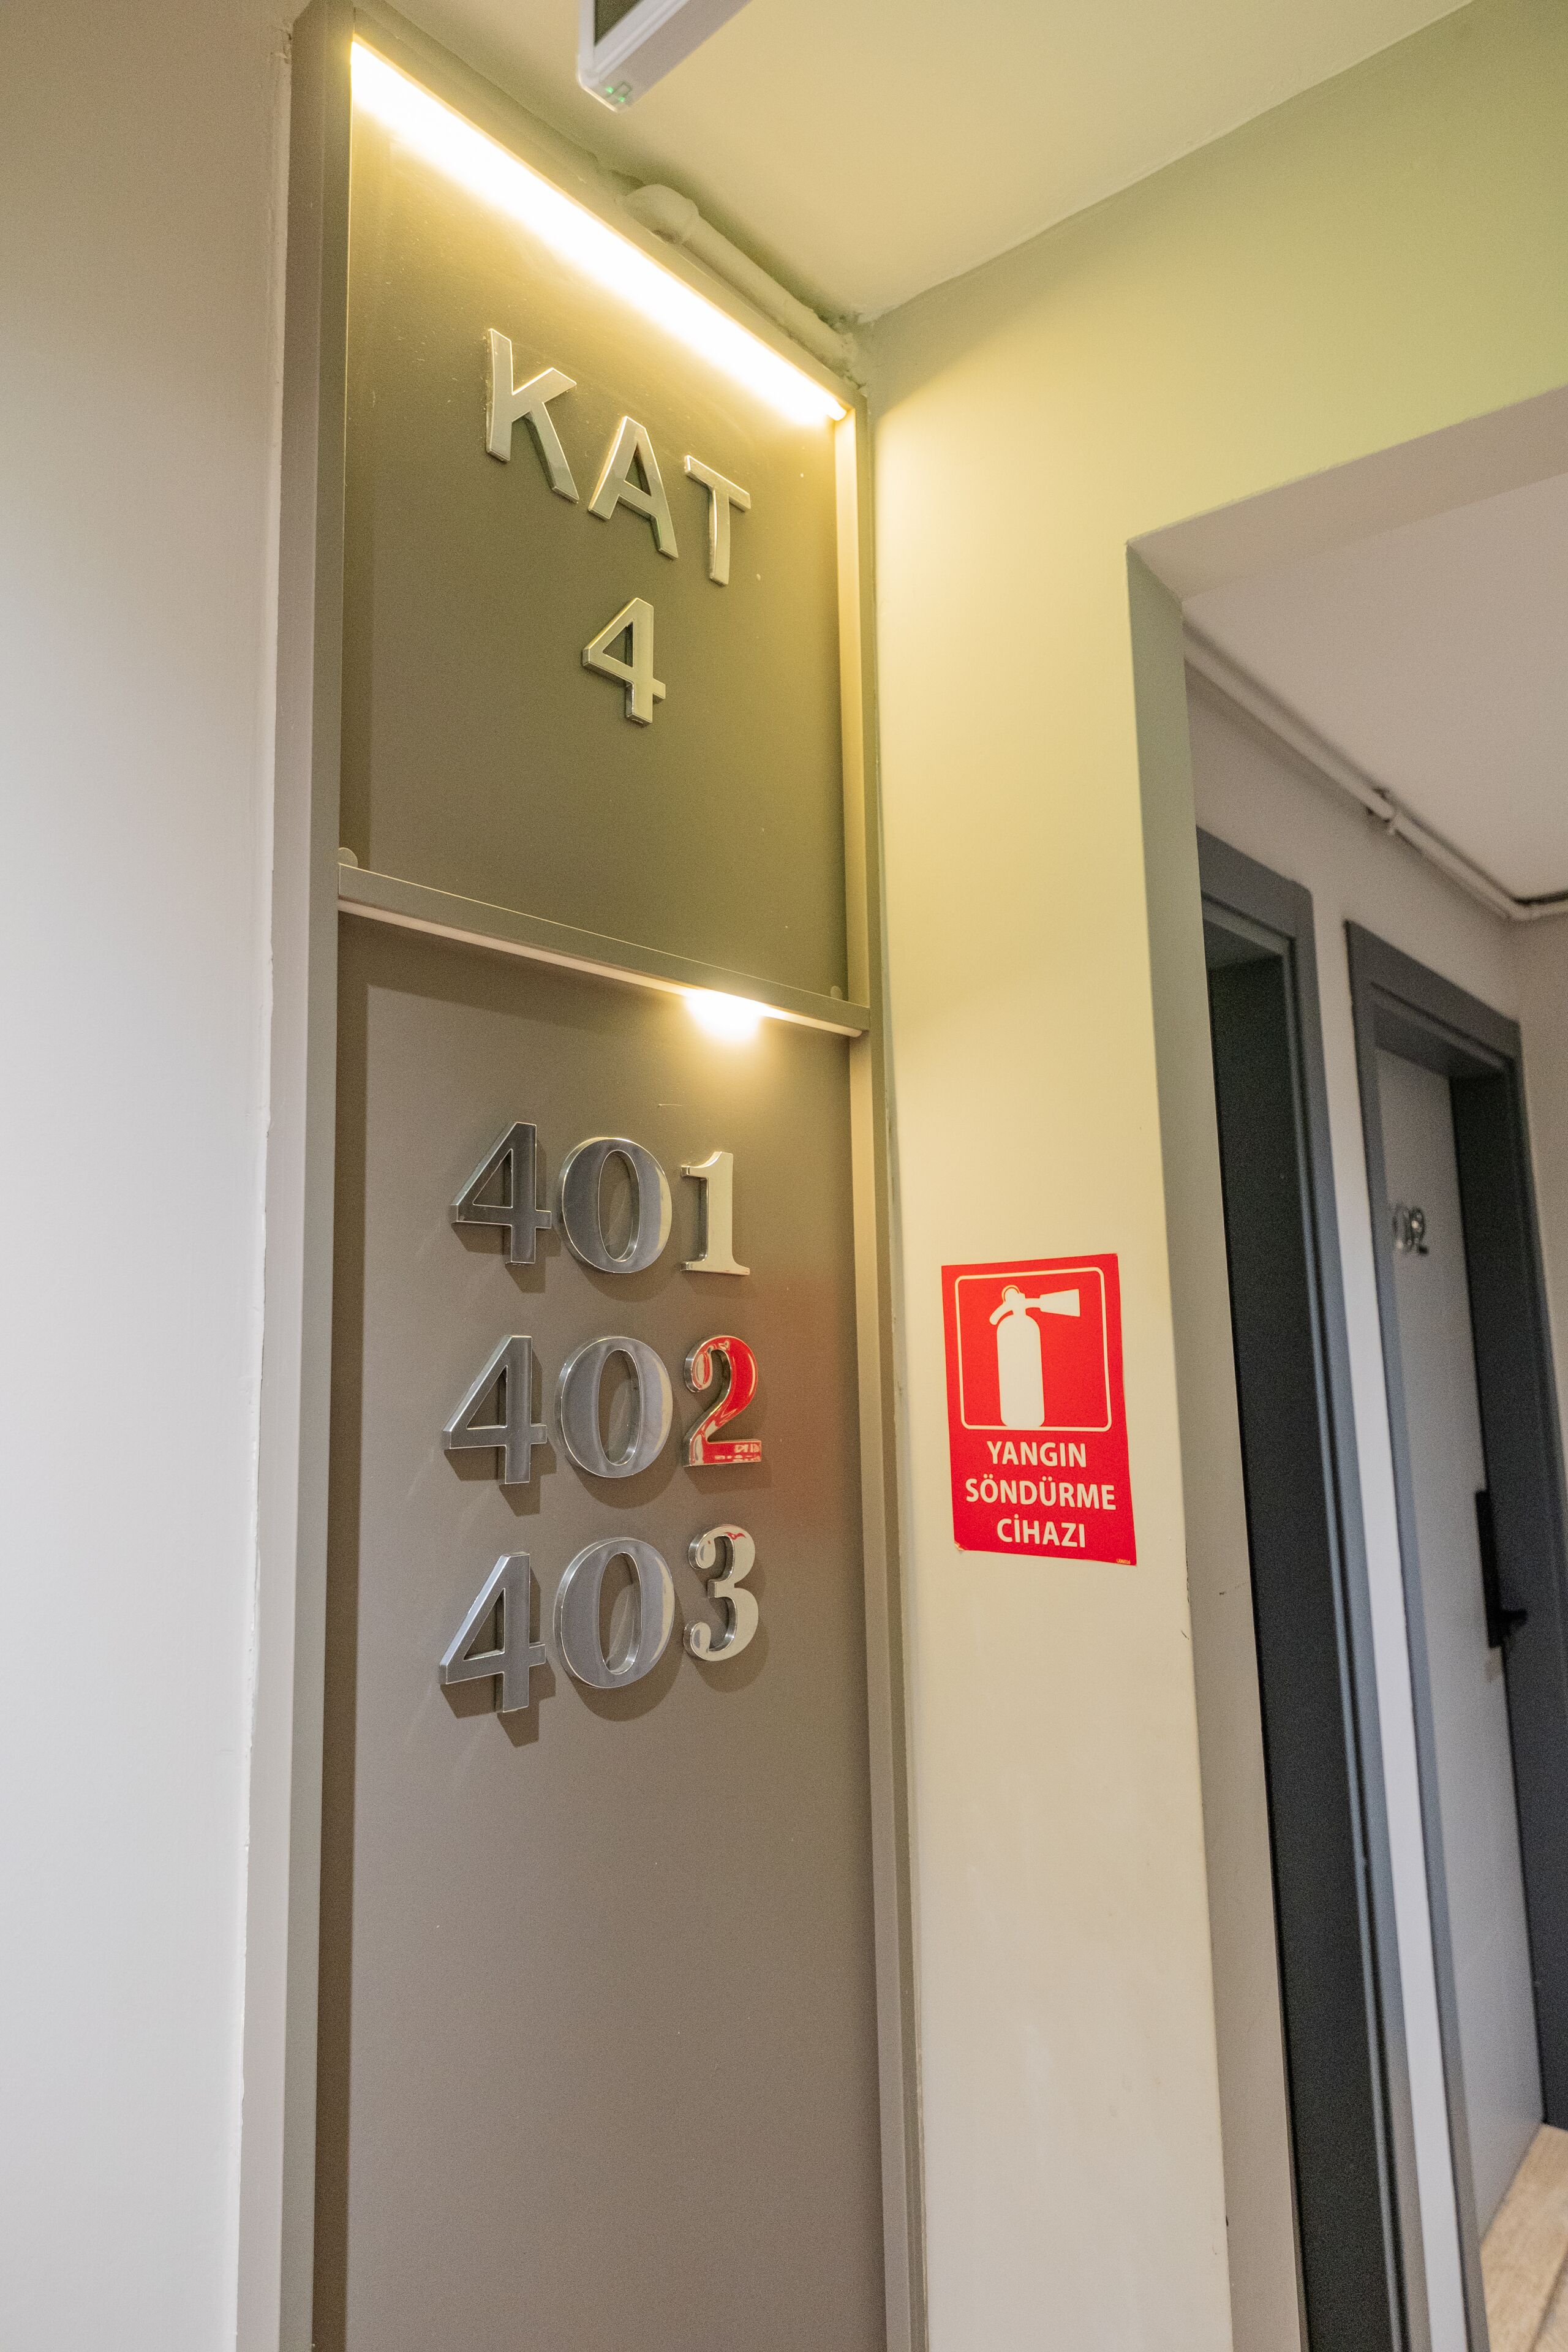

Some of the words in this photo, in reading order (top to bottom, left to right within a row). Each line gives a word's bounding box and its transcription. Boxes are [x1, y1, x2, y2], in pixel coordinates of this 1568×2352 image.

[486, 328, 751, 586] KAT
[582, 598, 666, 725] 4
[451, 1121, 750, 1275] 401
[443, 1335, 762, 1485] 402
[987, 1441, 1087, 1468] YANGIN
[965, 1474, 1117, 1510] SÖNDÜRME
[997, 1513, 1085, 1548] CİHAZI
[439, 1524, 759, 1713] 403
